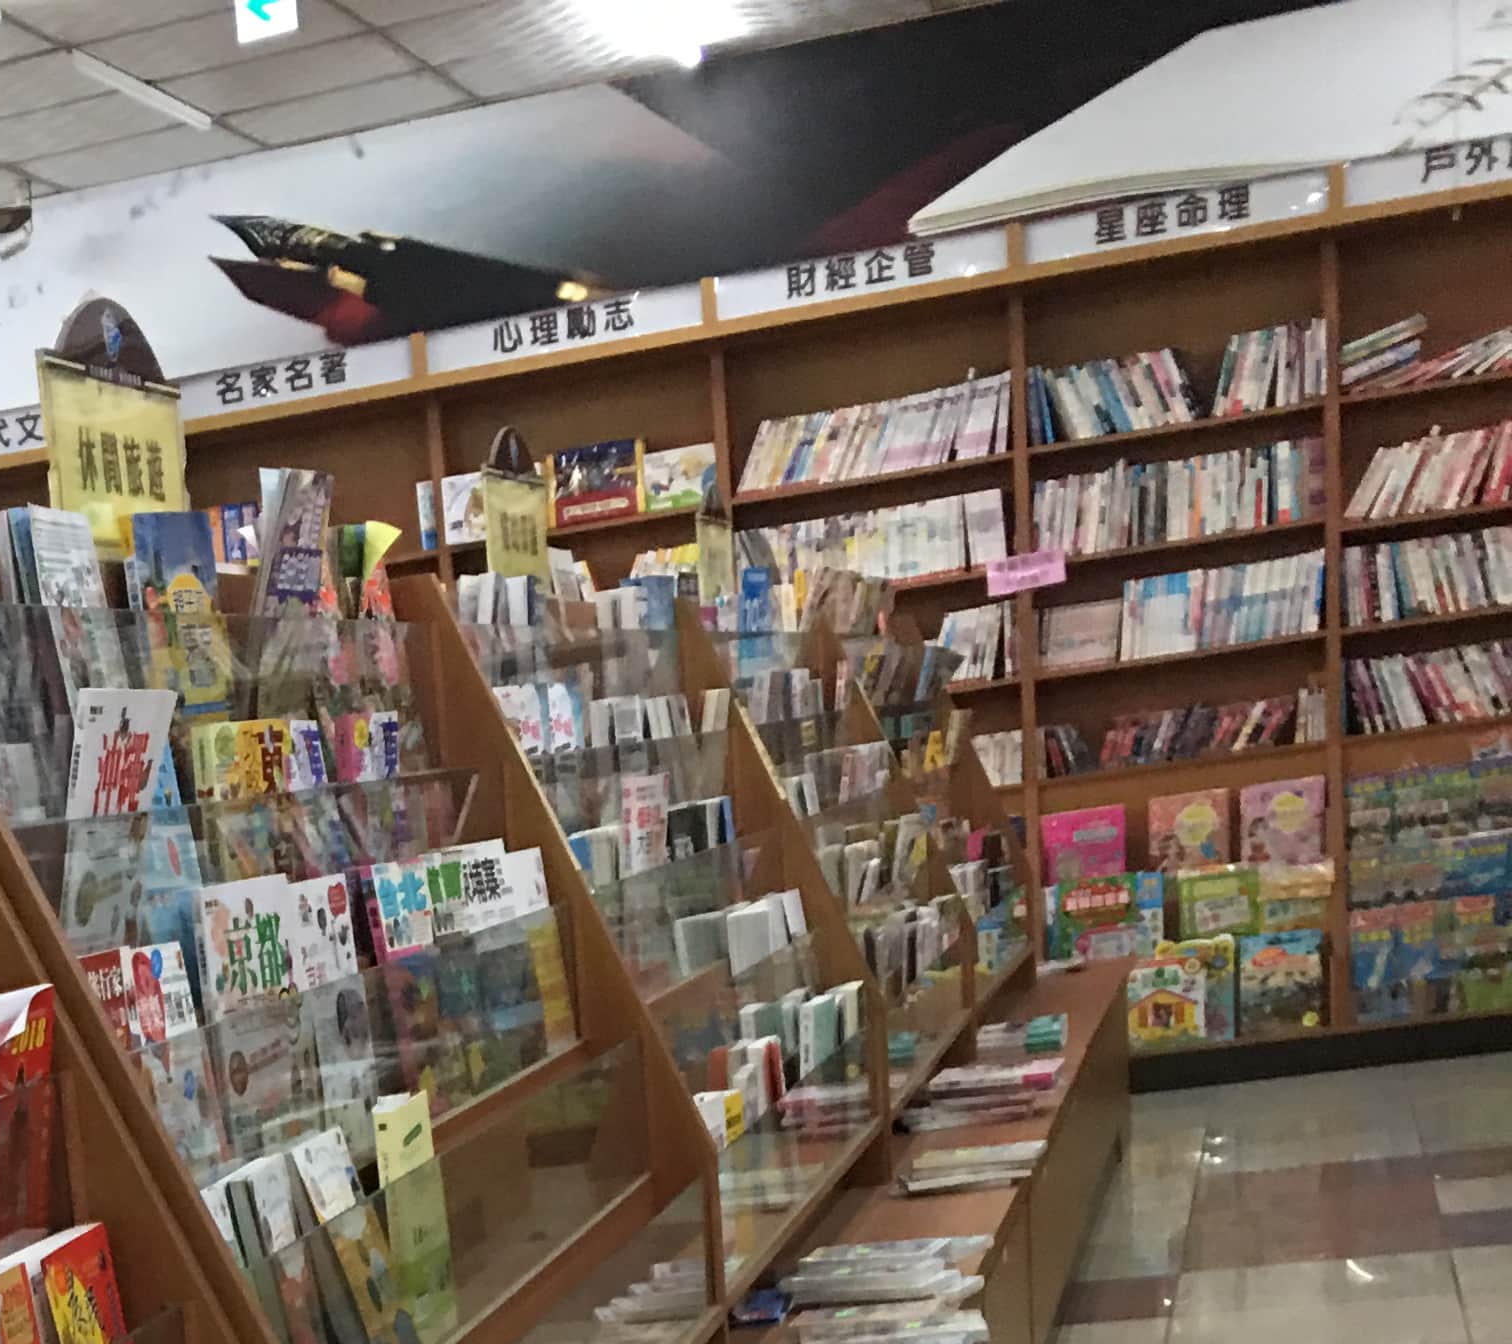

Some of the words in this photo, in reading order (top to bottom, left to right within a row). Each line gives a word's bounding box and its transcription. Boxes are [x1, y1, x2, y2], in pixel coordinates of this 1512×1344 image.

[1420, 140, 1512, 184] 戶外
[1093, 184, 1252, 244] 星座命理
[787, 241, 936, 298] 財經企管
[492, 296, 637, 355] 心理勵志
[214, 352, 350, 404] 名家名著
[225, 911, 289, 996] 京都
